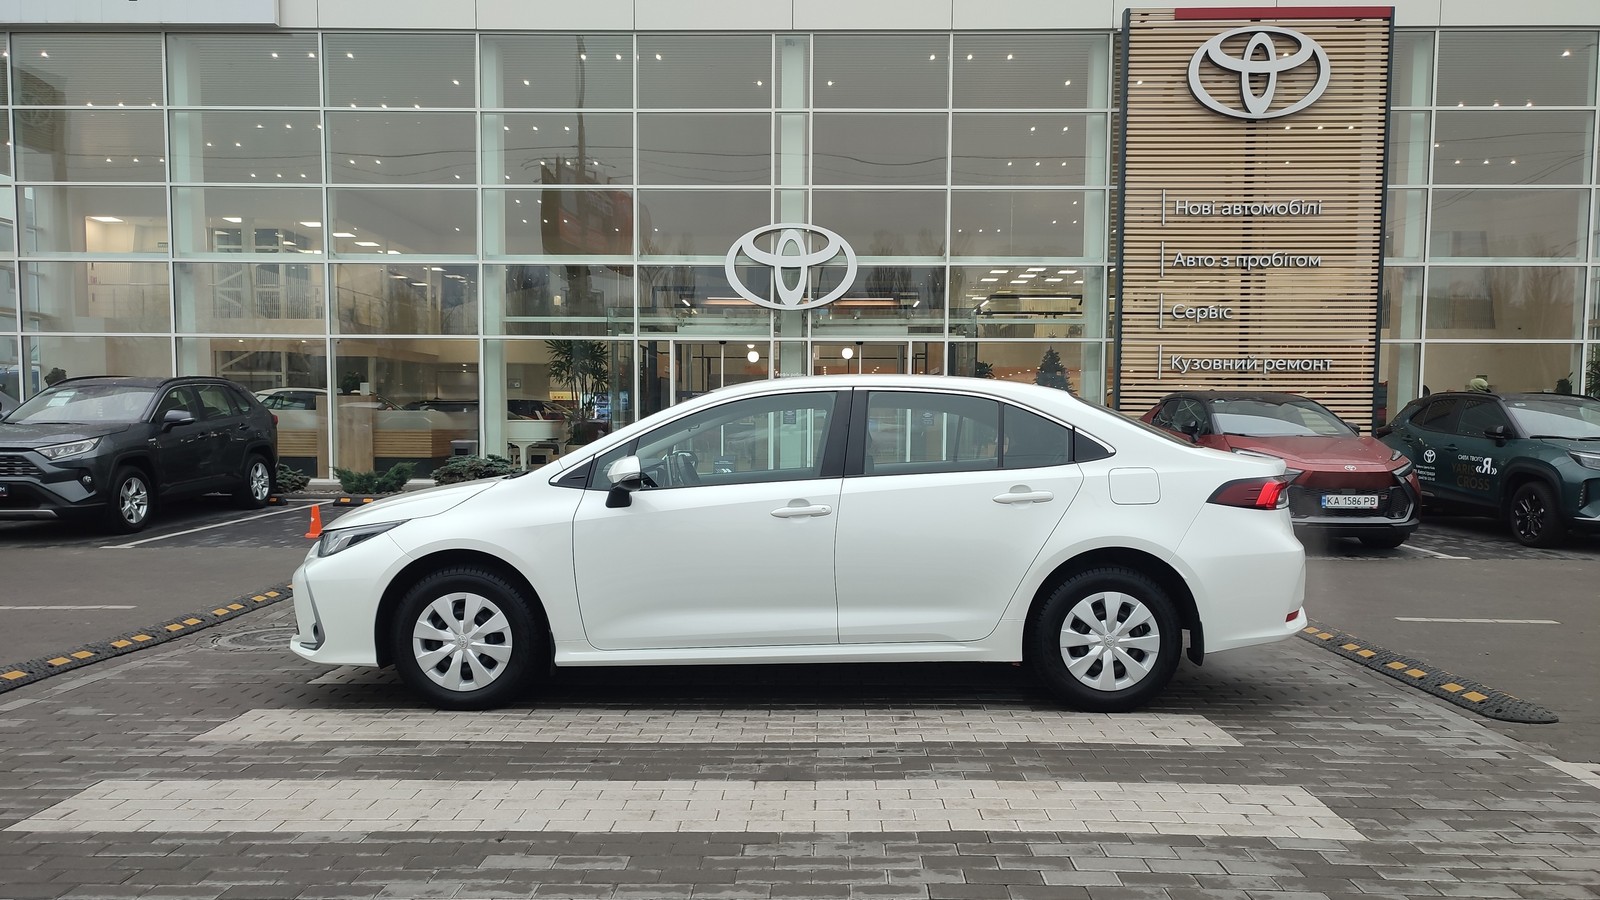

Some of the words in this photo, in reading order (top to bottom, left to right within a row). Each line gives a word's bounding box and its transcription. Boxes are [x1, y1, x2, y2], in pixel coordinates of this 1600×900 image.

[1174, 199, 1216, 216] Нові
[1220, 199, 1323, 216] автомобілі
[1172, 252, 1215, 268] Авто
[1220, 256, 1229, 268] з
[1235, 251, 1322, 271] пробігом
[1171, 303, 1233, 323] Сервіс
[1170, 354, 1258, 374] Кузовний
[1263, 358, 1333, 375] ремонт
[1451, 462, 1476, 476] YARIS
[1456, 475, 1490, 491] CROSS
[1327, 496, 1340, 506] KA
[1342, 496, 1362, 506] 1586
